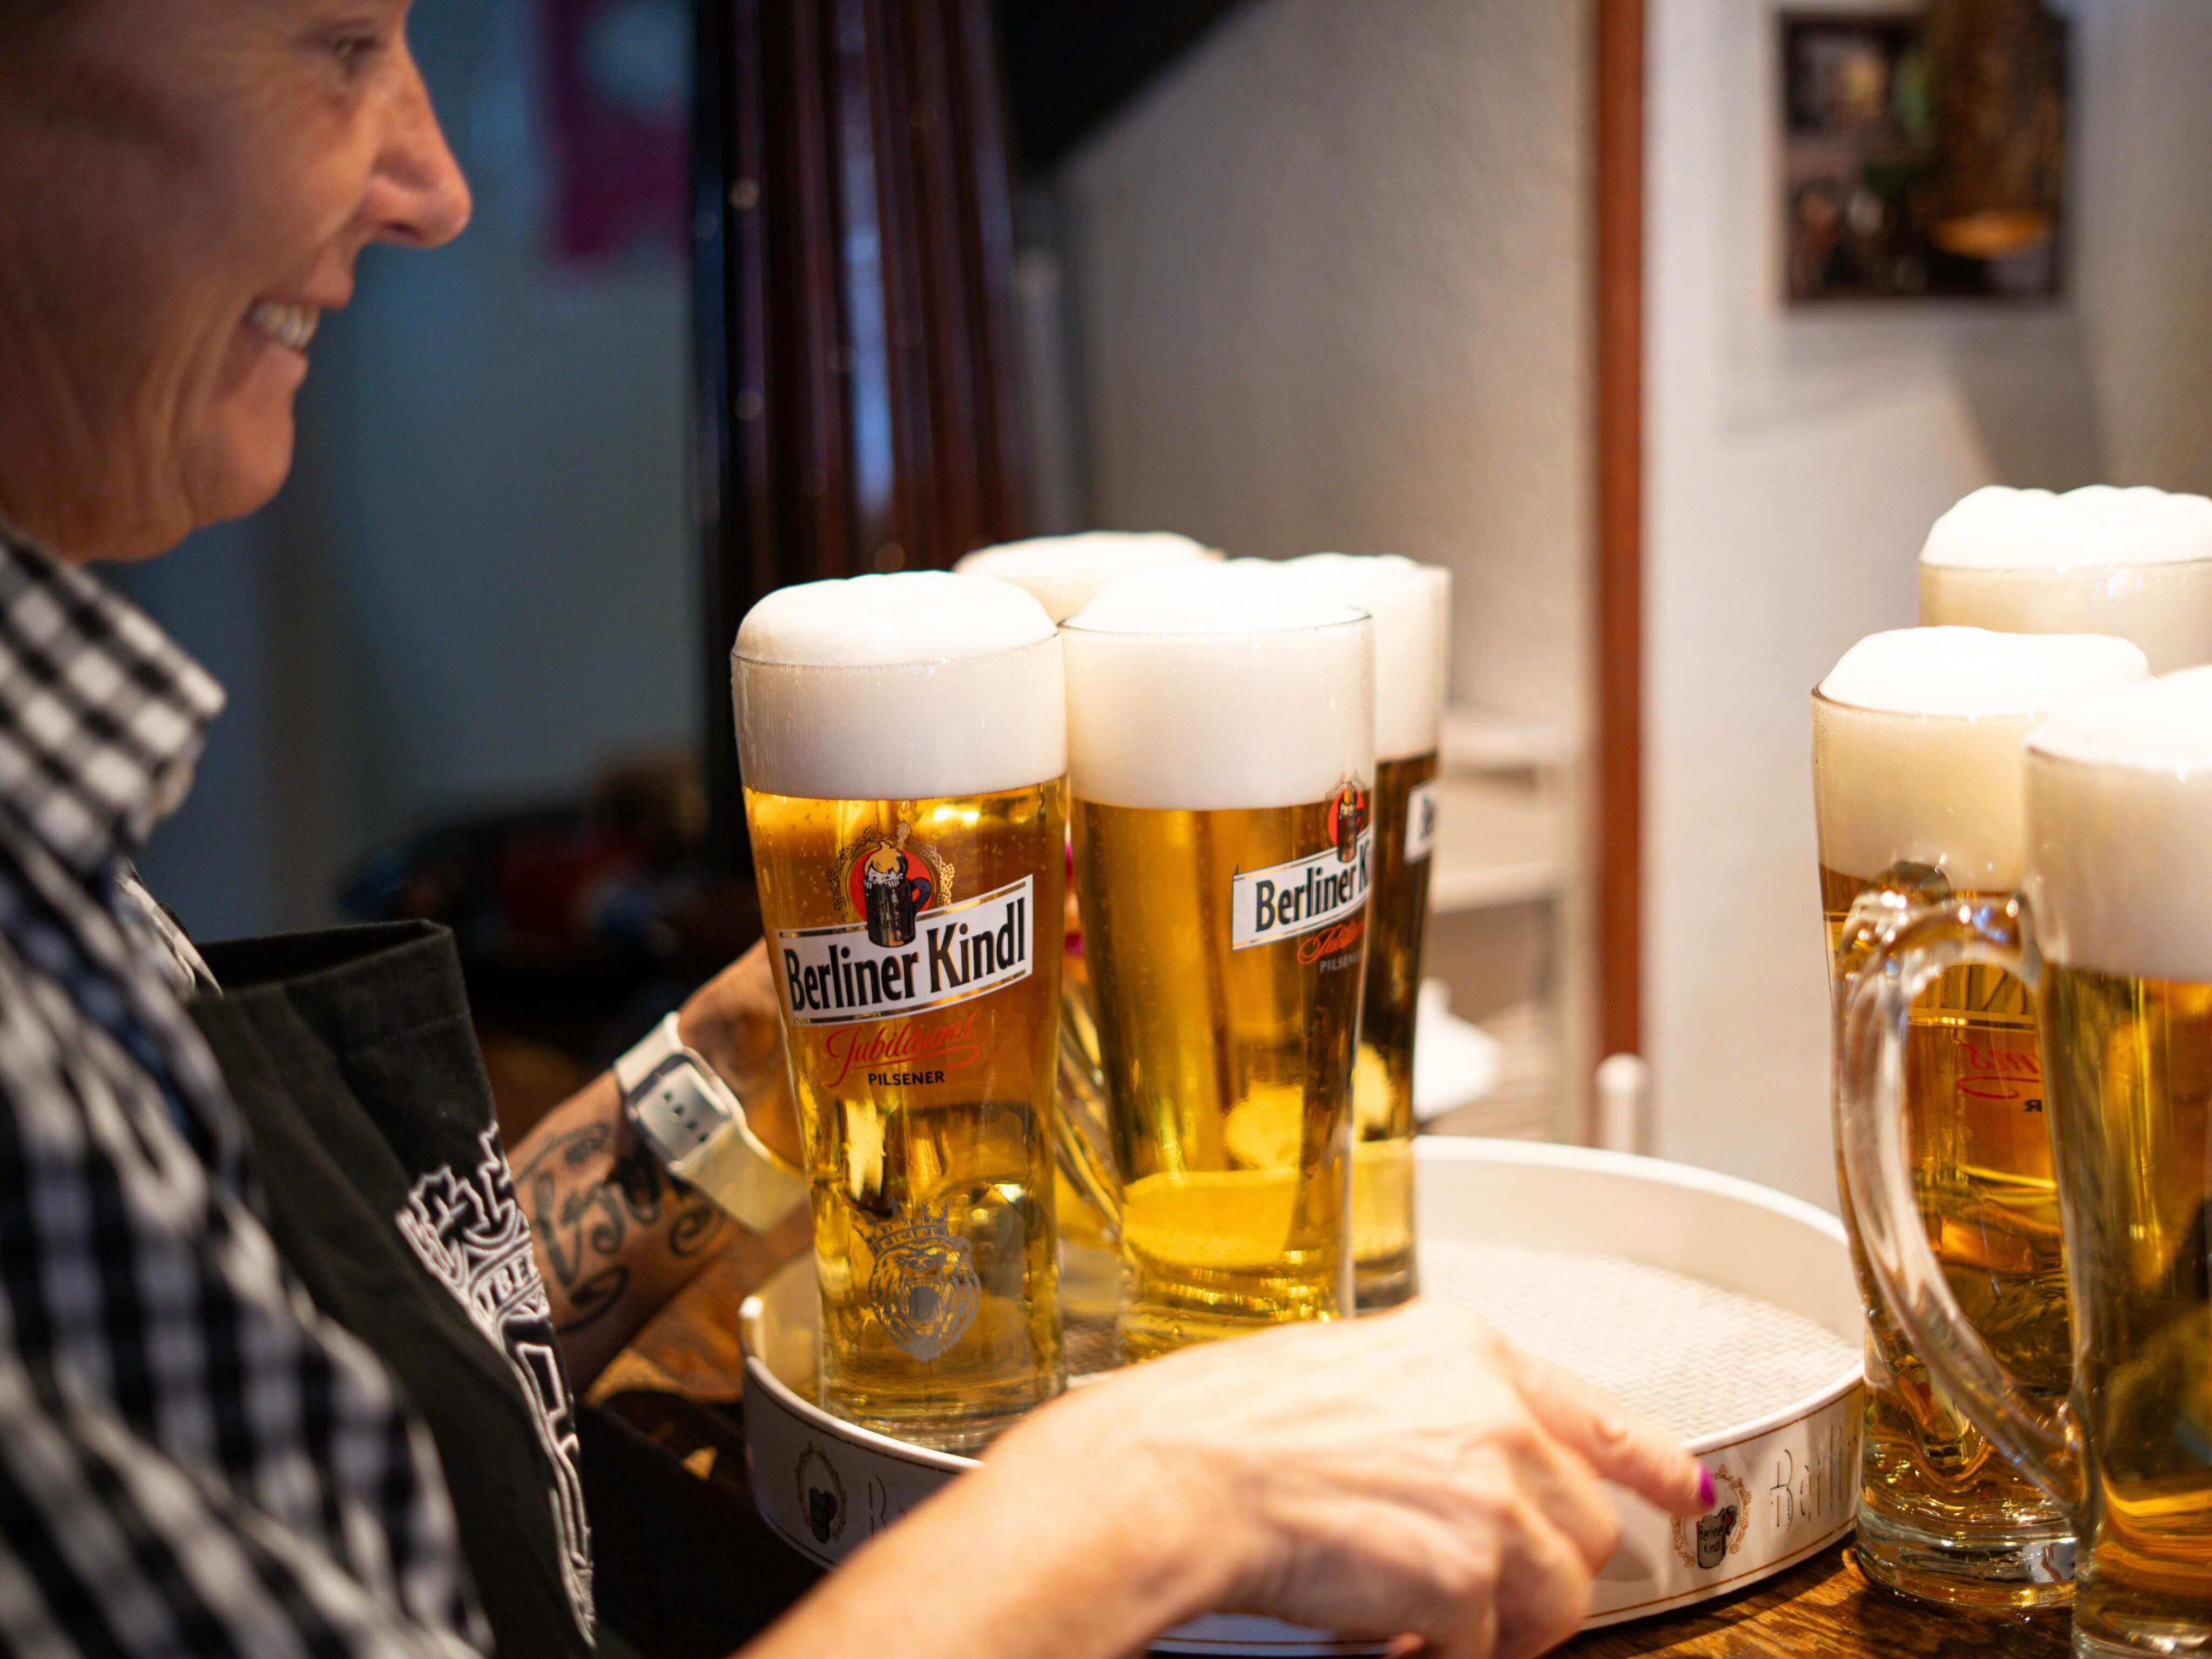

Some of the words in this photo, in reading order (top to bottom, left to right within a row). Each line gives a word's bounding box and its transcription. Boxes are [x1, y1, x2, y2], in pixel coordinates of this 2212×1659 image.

[1255, 865, 1356, 933] Berliner
[783, 943, 919, 1012] Berliner
[926, 896, 1026, 993] Kindl
[826, 1013, 980, 1088] Jubiläums
[868, 1070, 945, 1086] PILSENER
